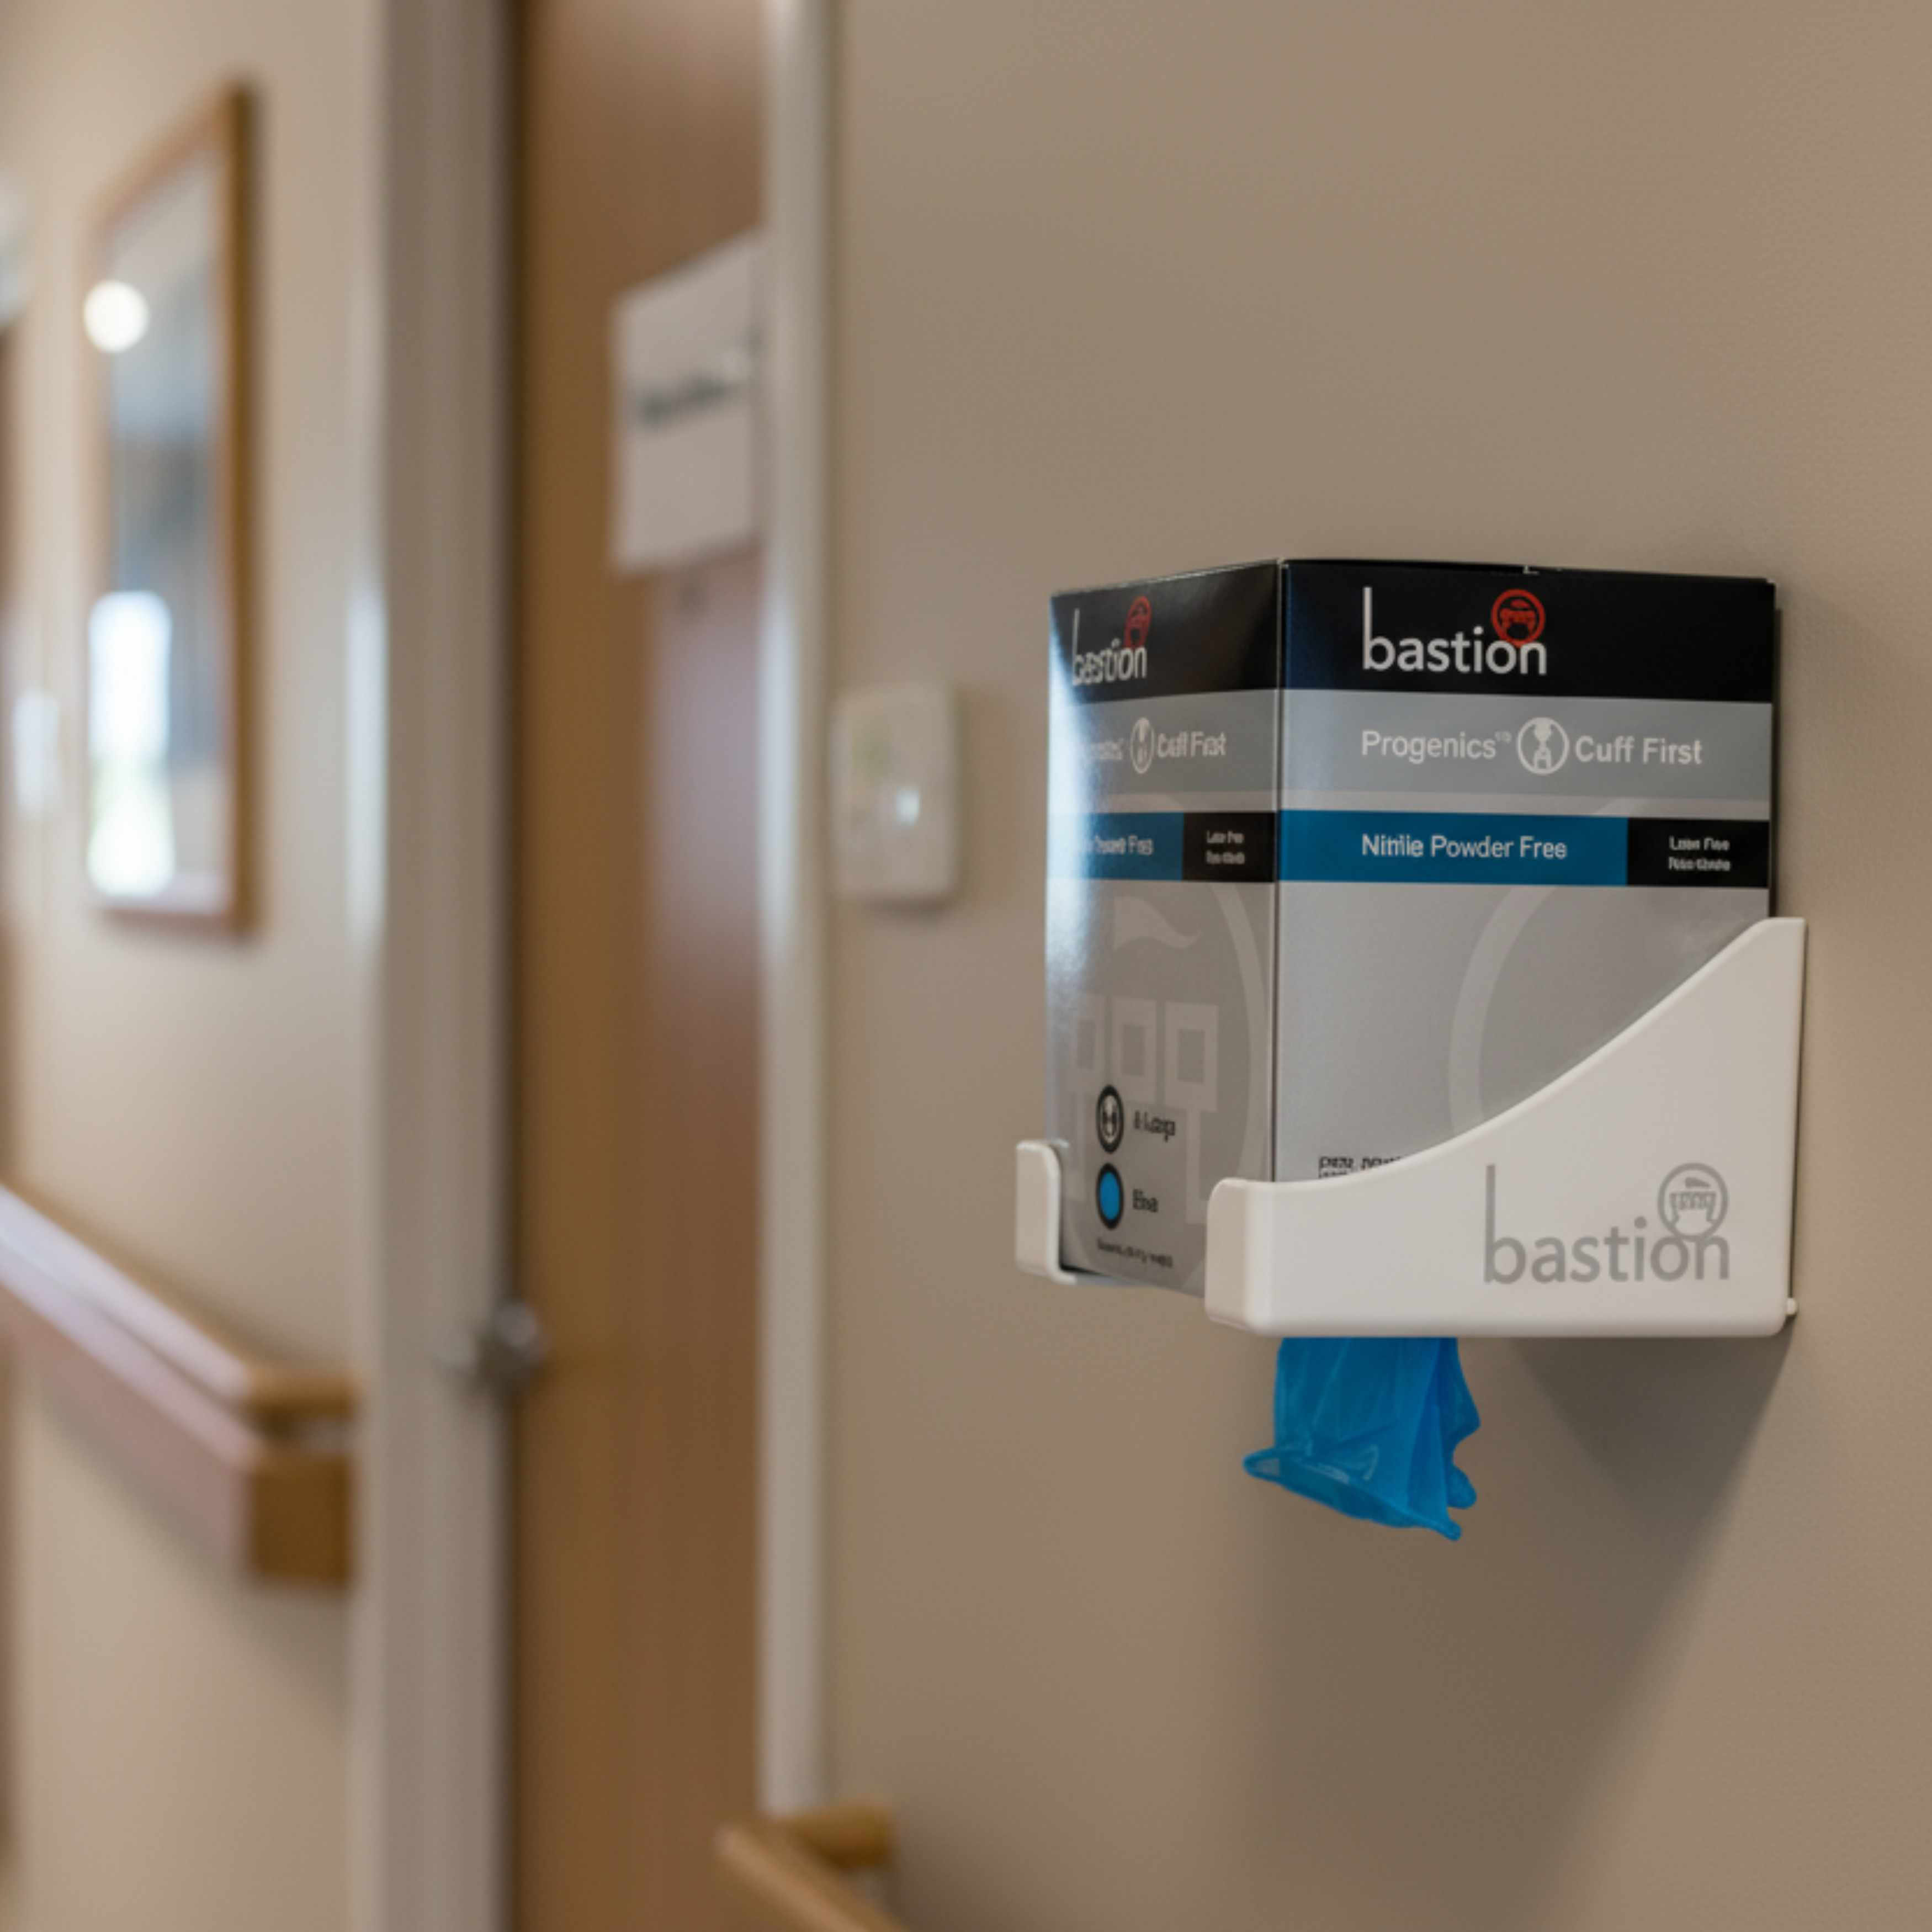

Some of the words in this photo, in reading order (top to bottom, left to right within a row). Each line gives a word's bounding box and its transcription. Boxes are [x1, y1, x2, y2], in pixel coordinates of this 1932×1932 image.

[1362, 586, 1547, 675] bastion
[1575, 735, 1634, 763] Cuff
[1643, 737, 1702, 765] First
[1431, 835, 1514, 858] Powder
[1483, 1164, 1730, 1284] bastion
